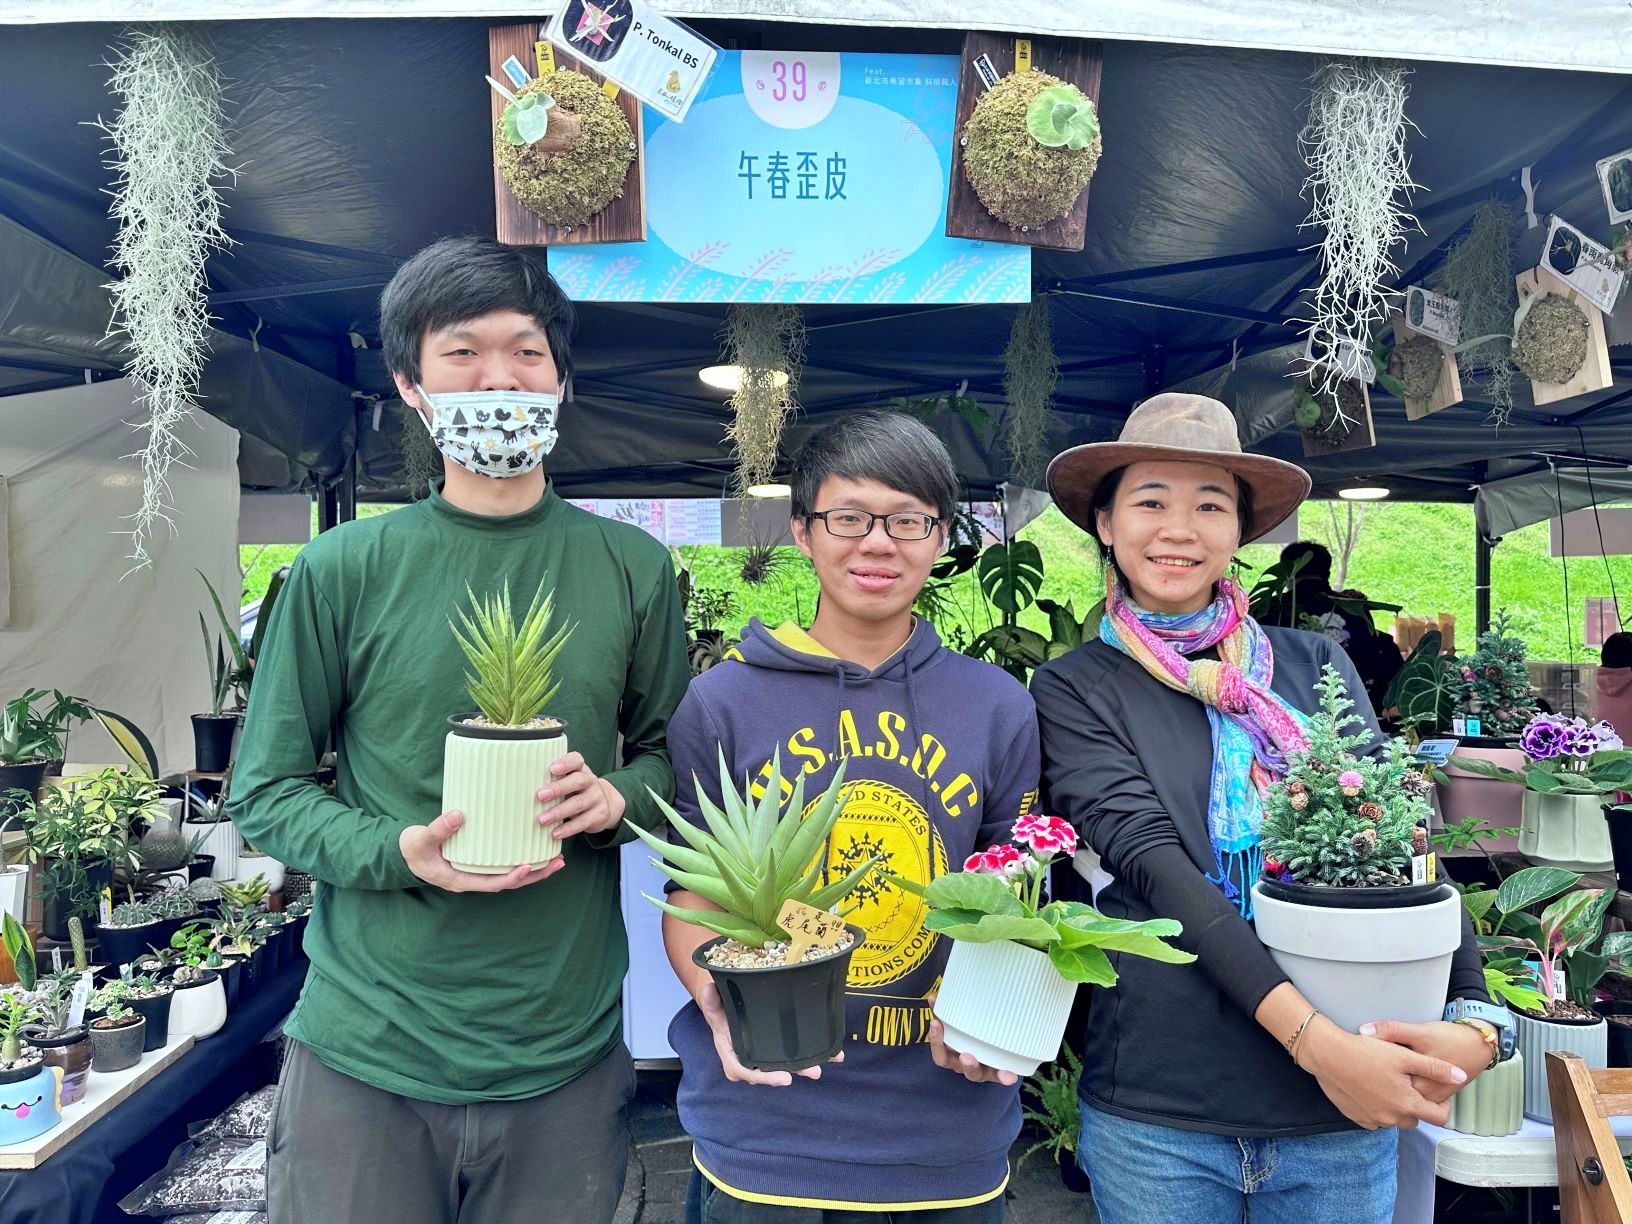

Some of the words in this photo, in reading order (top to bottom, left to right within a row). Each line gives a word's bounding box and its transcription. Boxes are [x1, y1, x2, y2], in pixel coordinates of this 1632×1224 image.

[633, 21, 643, 36] P.
[646, 28, 683, 60] Tonkal
[682, 52, 699, 69] BS
[771, 60, 807, 103] 39
[864, 67, 885, 75] Feat.
[864, 76, 923, 86] 新北市希望市集
[737, 150, 848, 201] 午春歪皮
[871, 791, 927, 836] STATES
[848, 955, 905, 977] TIONS
[903, 920, 931, 958] COM
[866, 1005, 914, 1047] OWN
